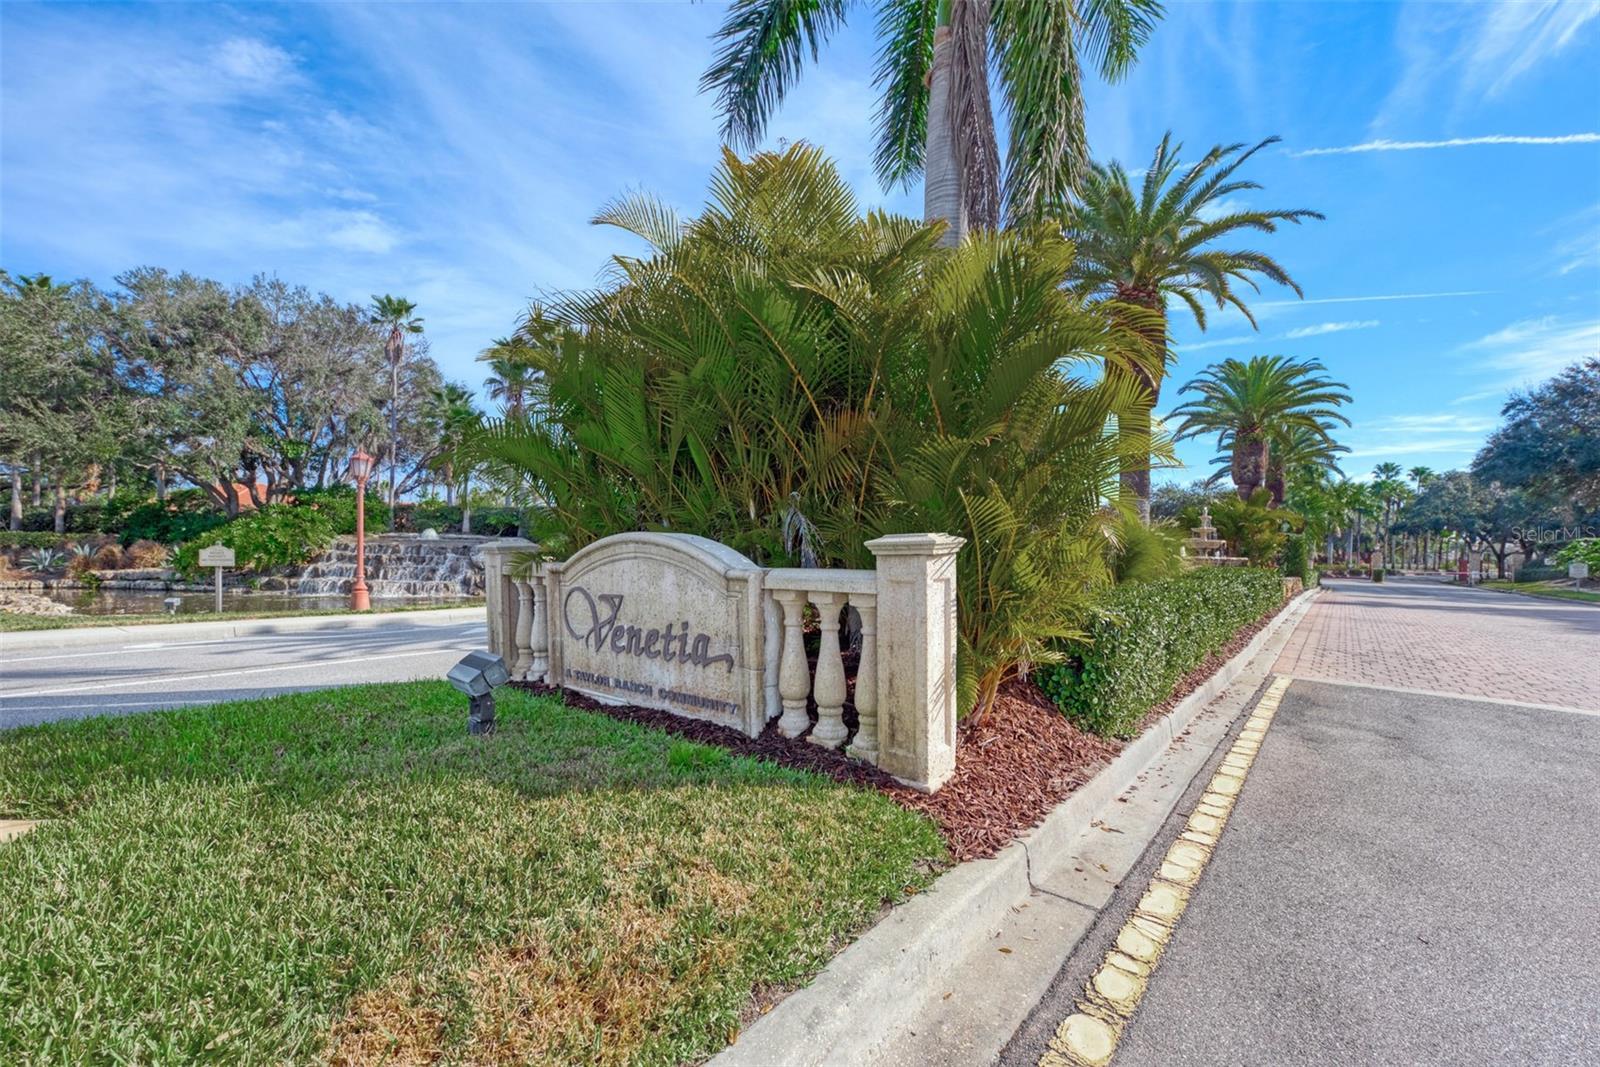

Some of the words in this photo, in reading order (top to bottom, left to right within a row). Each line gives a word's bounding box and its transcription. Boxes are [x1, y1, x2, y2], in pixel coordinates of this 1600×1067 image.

[564, 586, 734, 673] Venetia
[565, 669, 573, 679] A
[574, 670, 610, 687] TAYLOR
[614, 678, 653, 696] RANCH
[658, 688, 738, 715] COMMUNITY
